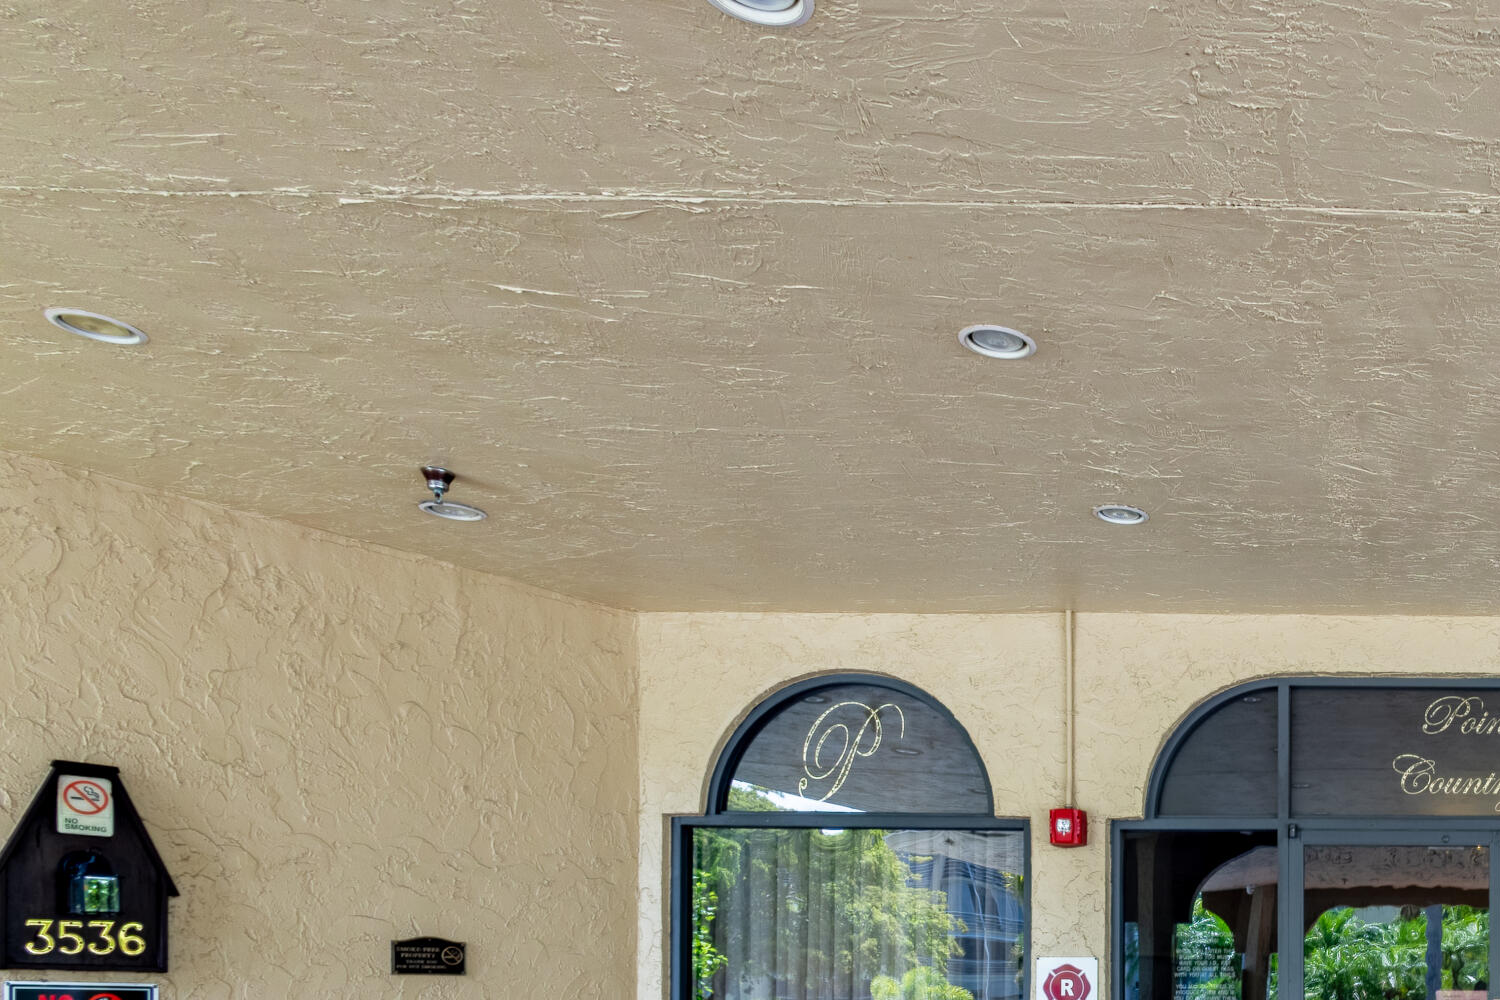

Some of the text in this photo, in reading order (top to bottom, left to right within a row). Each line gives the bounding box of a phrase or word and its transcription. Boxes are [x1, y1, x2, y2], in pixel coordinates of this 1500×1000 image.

[798, 701, 905, 802] P
[64, 823, 107, 833] SMOKING
[25, 919, 146, 955] 3536
[1060, 979, 1074, 997] R
